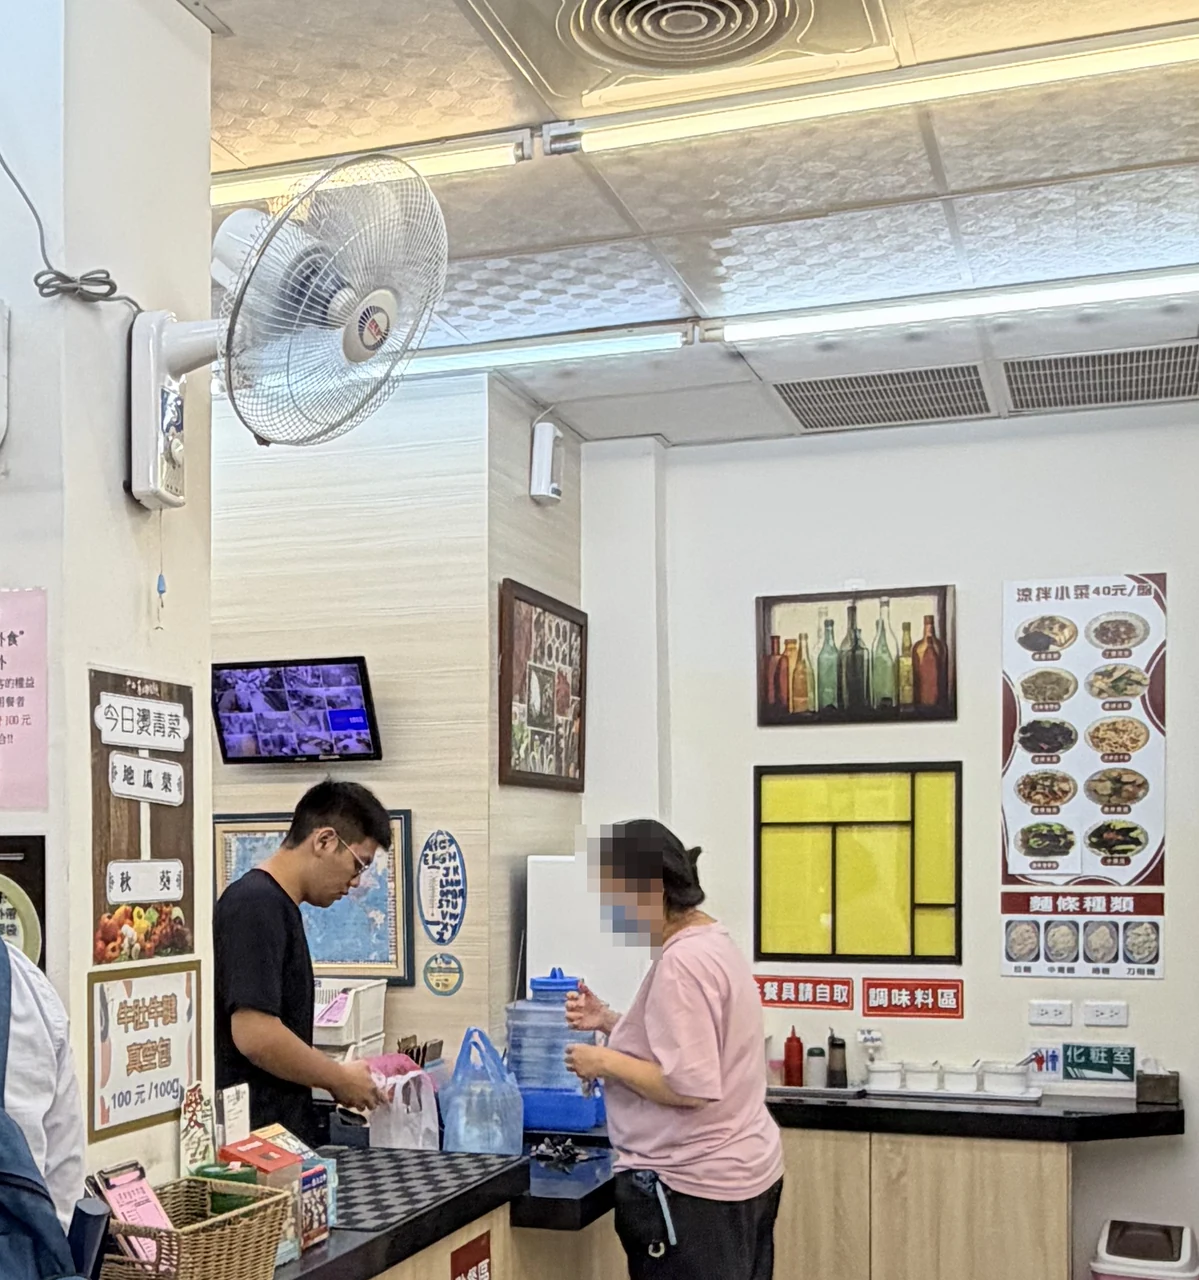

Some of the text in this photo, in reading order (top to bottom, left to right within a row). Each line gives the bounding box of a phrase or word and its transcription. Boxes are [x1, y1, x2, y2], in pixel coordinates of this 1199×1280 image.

[103, 703, 181, 739] 今日燙青菜
[868, 988, 958, 1009] 調味料區
[126, 1037, 172, 1077] 真空包
